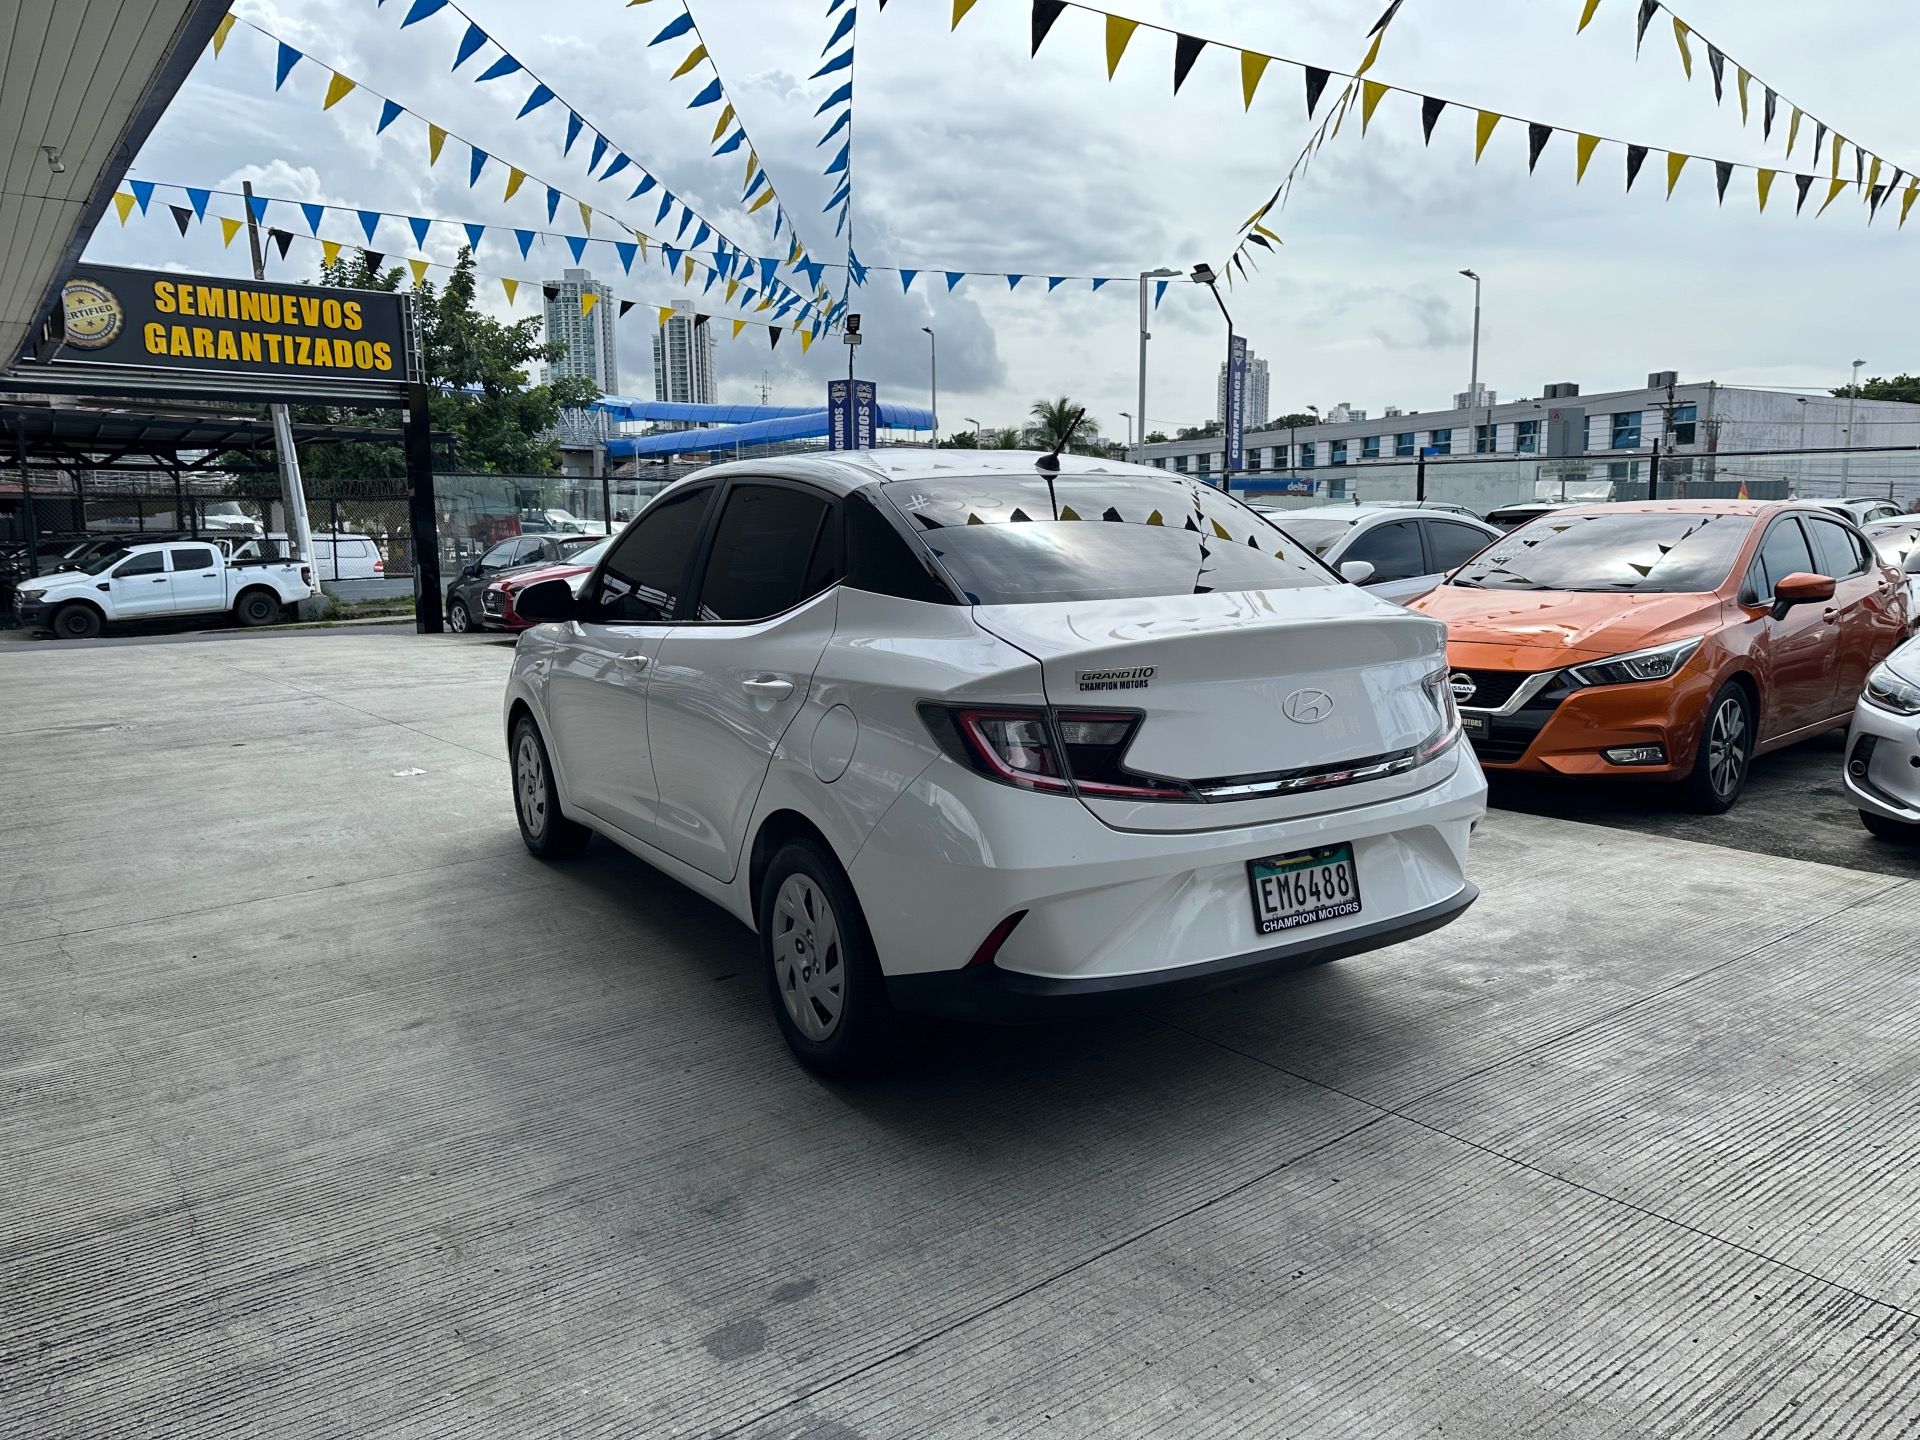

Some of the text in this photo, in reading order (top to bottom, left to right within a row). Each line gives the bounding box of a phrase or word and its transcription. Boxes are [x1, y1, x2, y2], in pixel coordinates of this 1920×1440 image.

[67, 304, 113, 320] ERTIFIED
[153, 281, 362, 331] SEMINUEVOS
[143, 322, 393, 371] GARANTIZADOS
[834, 407, 844, 451] CIAMOS
[858, 406, 870, 451] DEMOS
[1232, 371, 1240, 459] COMPRAMOS
[1287, 481, 1308, 491] delta
[1079, 679, 1148, 692] CHAMPION MOTORS
[1081, 671, 1130, 681] GRAND
[1260, 863, 1350, 914] EM6488
[1262, 911, 1317, 933] CHAMPION
[1318, 901, 1360, 919] MOTORS
